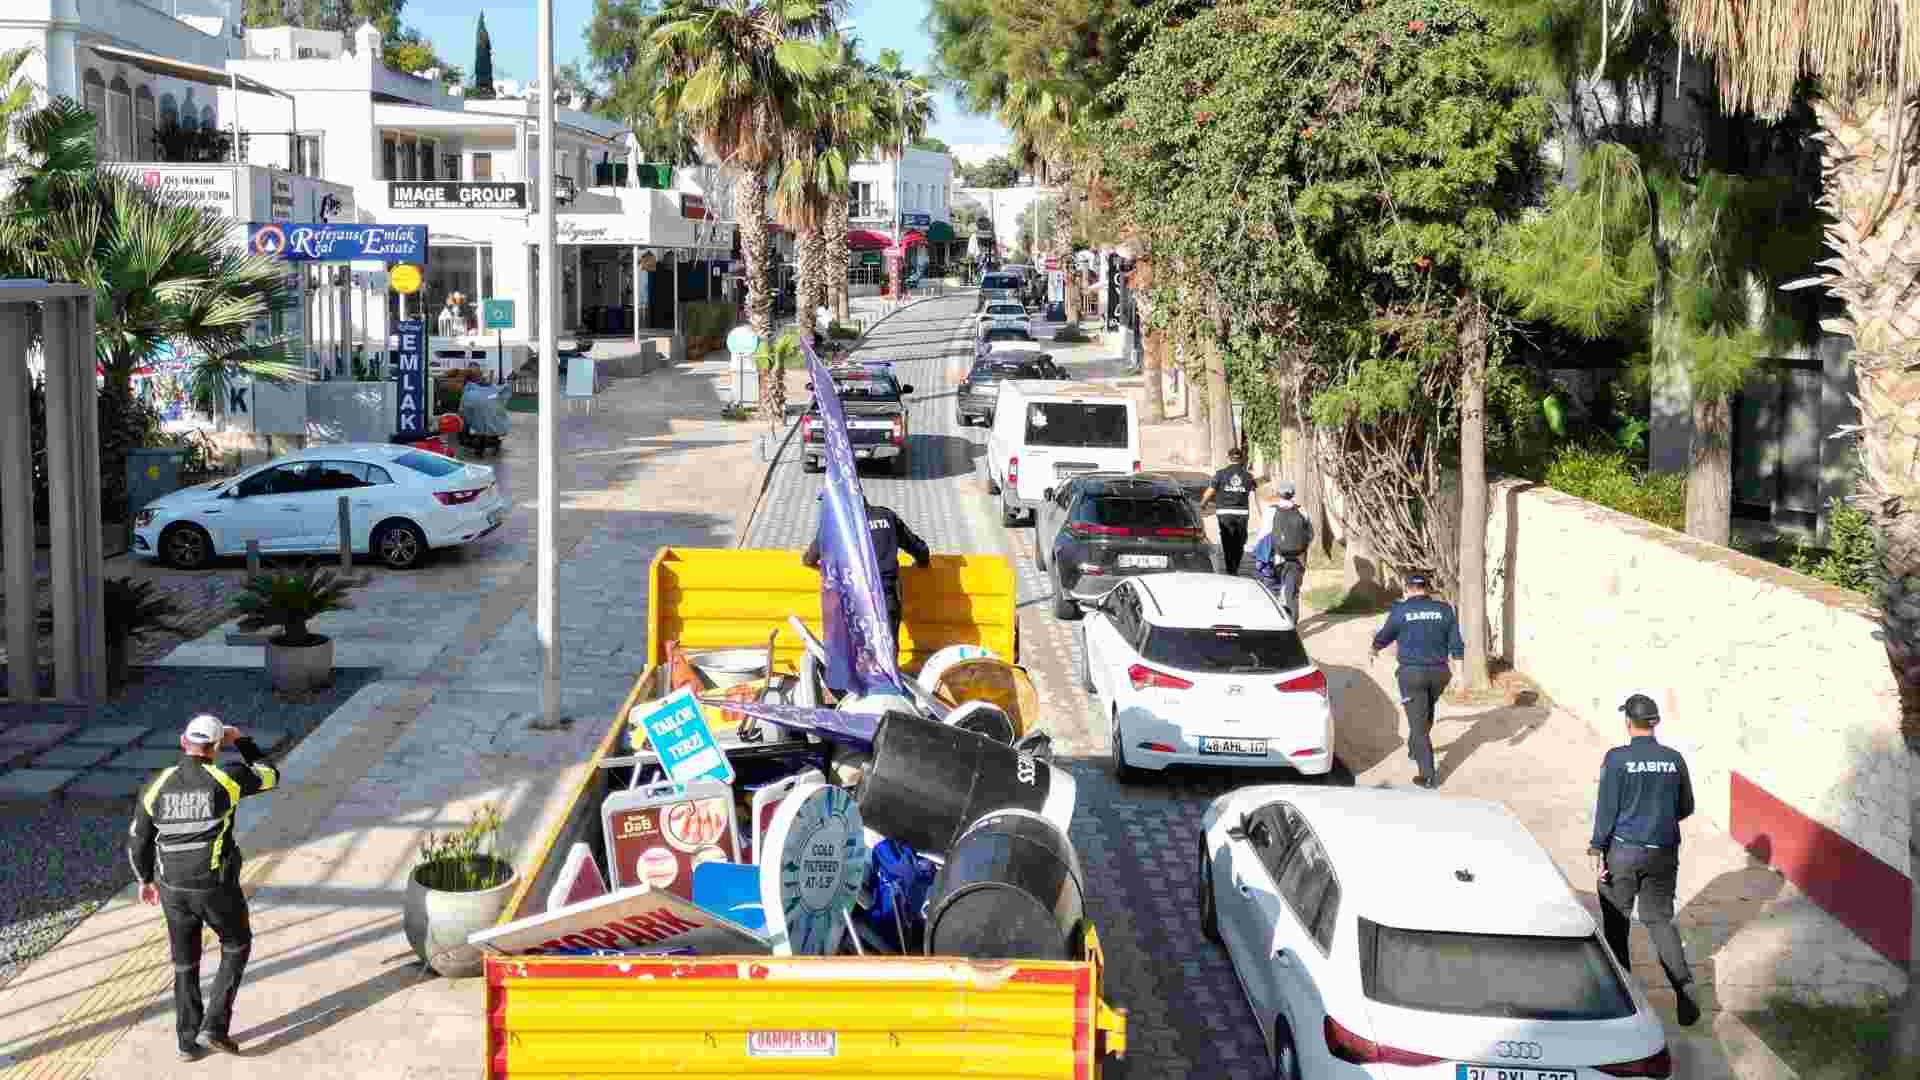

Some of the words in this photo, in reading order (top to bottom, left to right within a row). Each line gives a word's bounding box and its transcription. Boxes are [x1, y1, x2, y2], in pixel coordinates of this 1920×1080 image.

[394, 187, 445, 201] IMAGE
[459, 188, 517, 201] GROUP
[290, 227, 359, 254] Referans
[360, 226, 416, 253] Emlak
[400, 334, 418, 430] EMLAK
[1406, 610, 1442, 621] ZABITA
[1625, 760, 1678, 773] ZABITA
[811, 843, 835, 857] COLD
